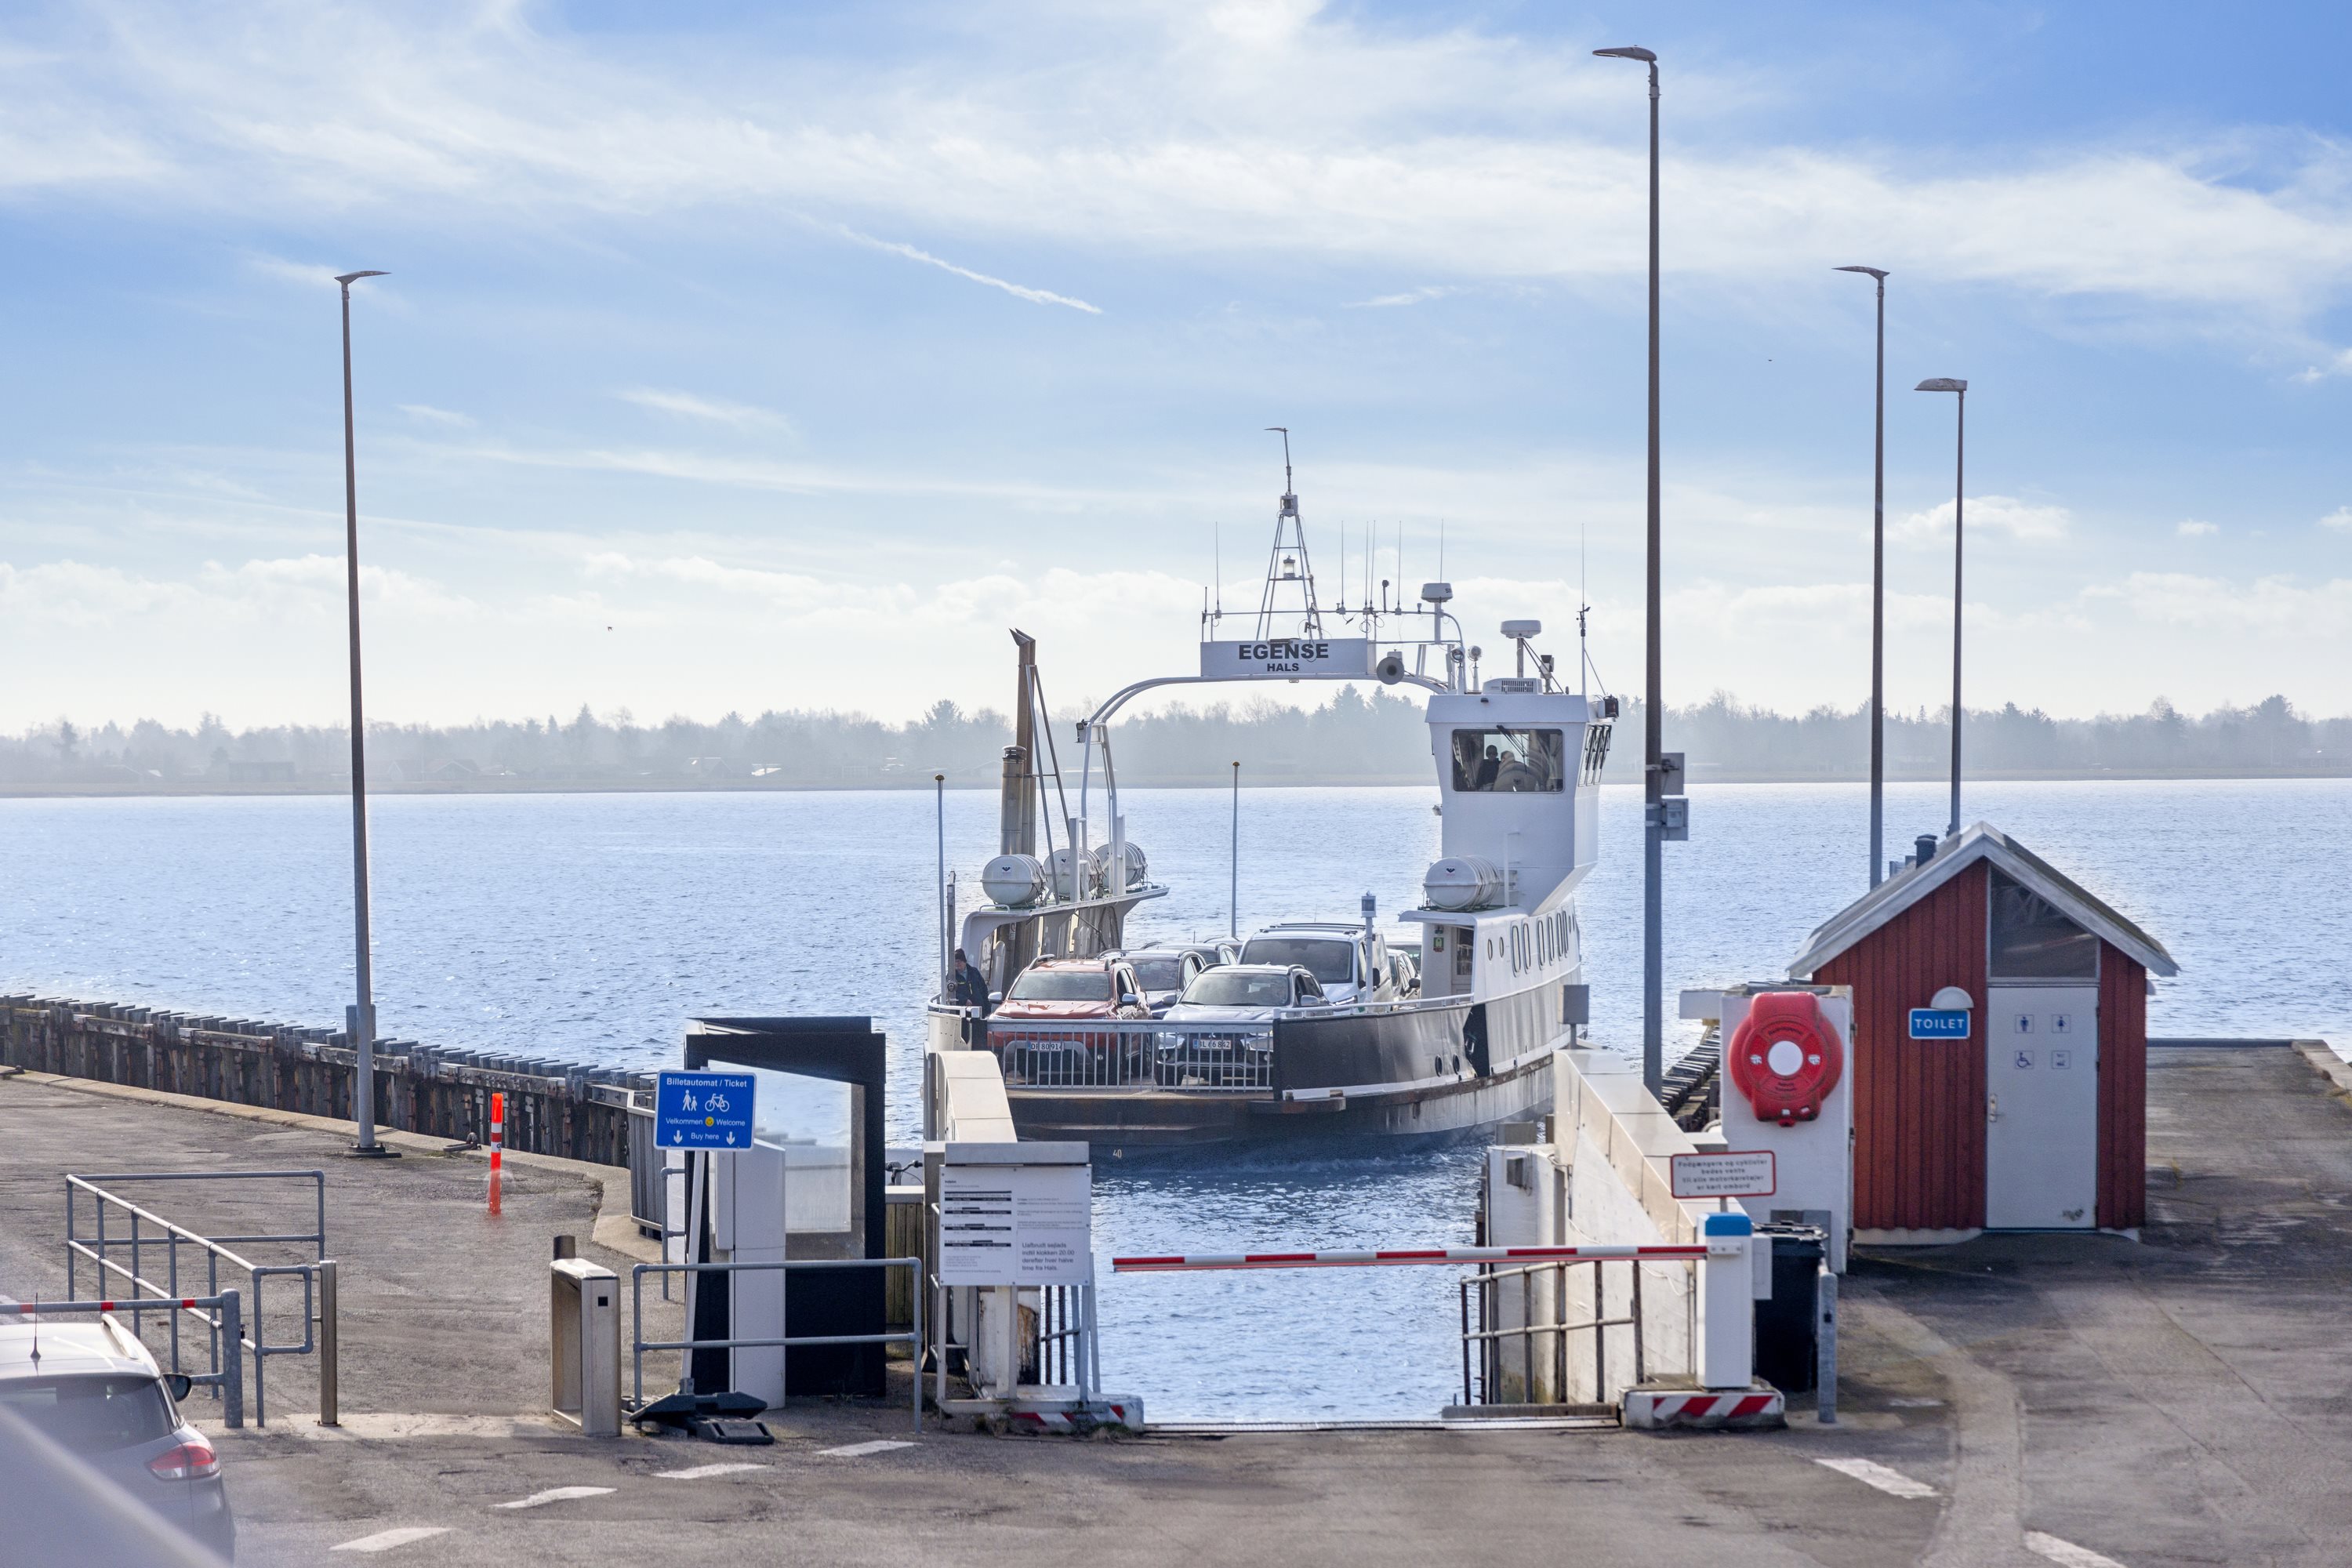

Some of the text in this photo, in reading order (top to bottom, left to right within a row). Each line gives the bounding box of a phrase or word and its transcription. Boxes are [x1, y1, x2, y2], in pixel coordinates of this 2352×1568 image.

[1239, 643, 1329, 660] EGENSE
[1267, 663, 1299, 672] HALS
[1914, 1018, 1965, 1029] TOILET
[666, 1077, 717, 1087] Billetautomat
[724, 1079, 747, 1087] Ticket
[691, 1132, 703, 1141] Buy
